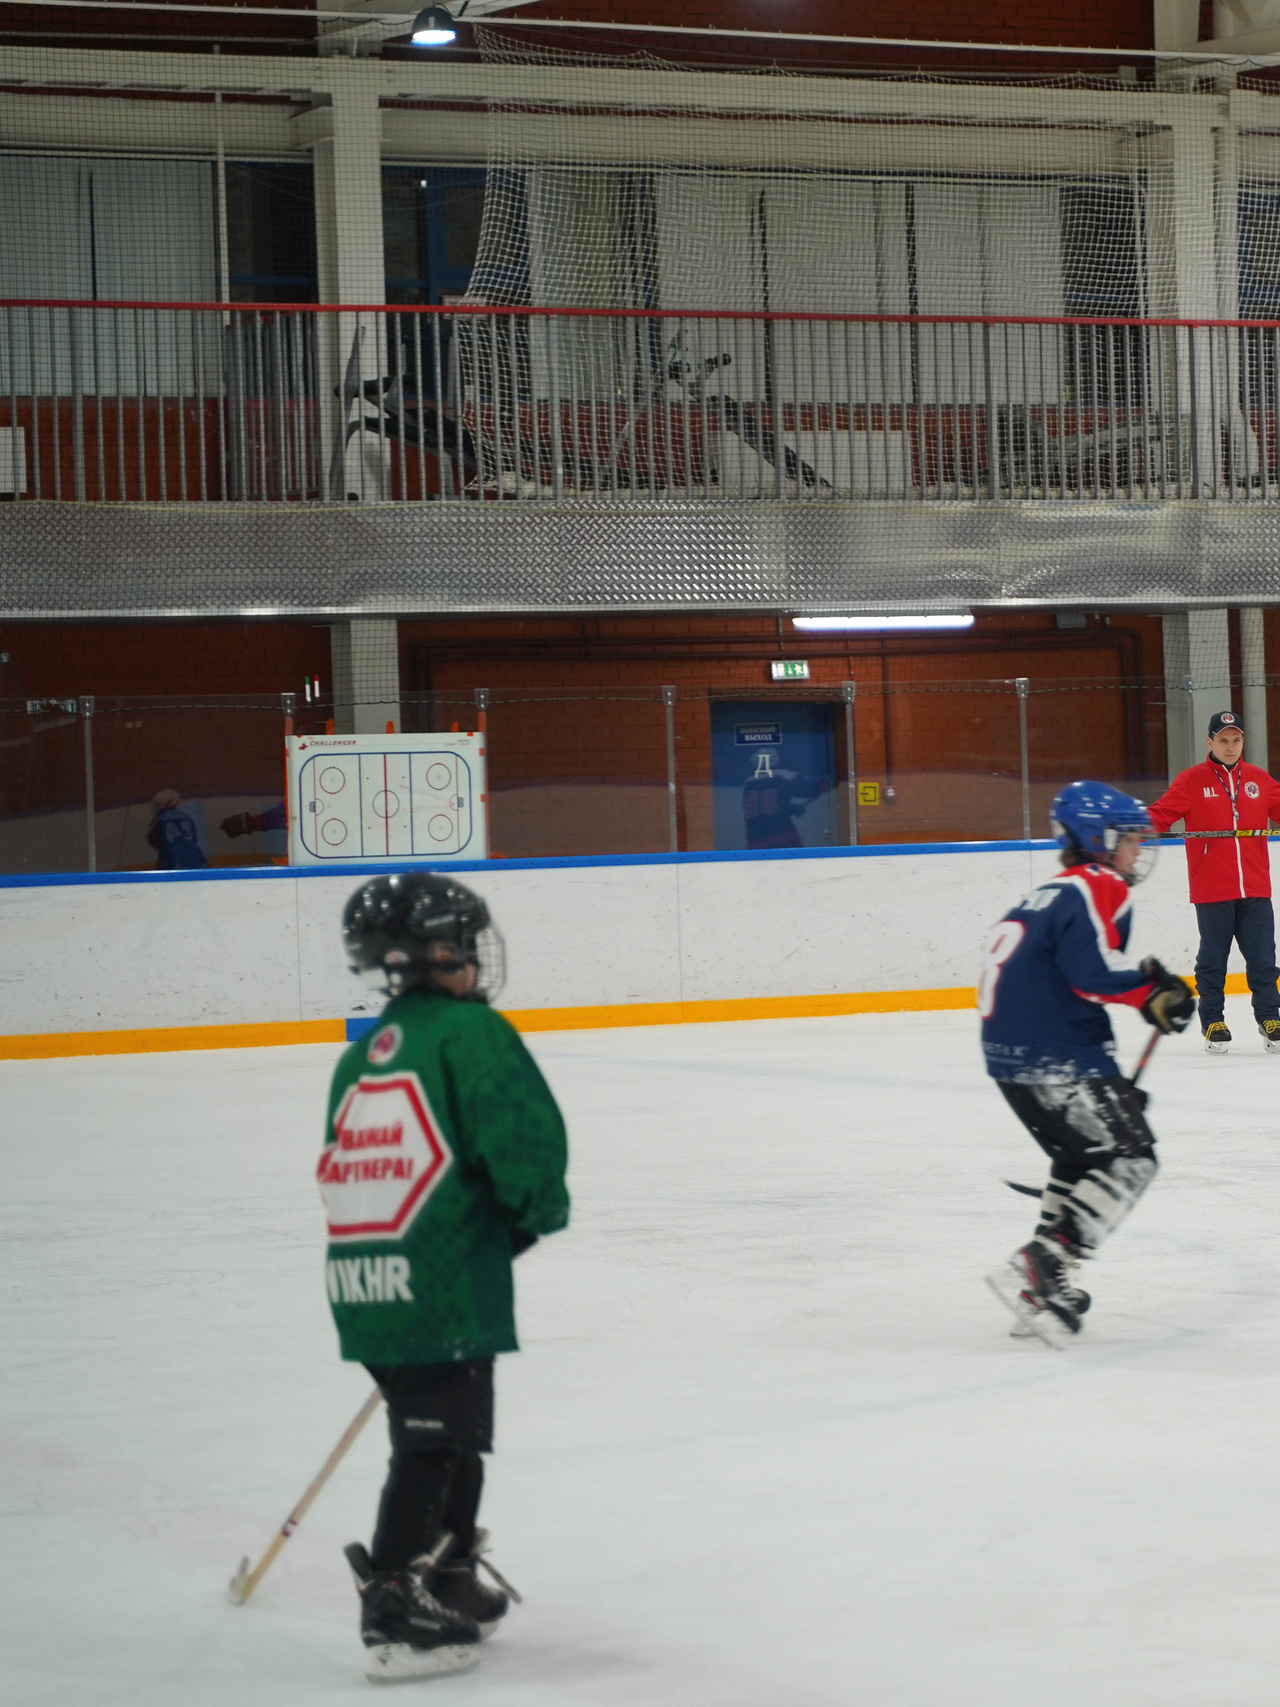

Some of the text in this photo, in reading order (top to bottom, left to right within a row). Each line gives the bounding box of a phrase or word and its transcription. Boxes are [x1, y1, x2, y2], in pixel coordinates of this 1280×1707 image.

[754, 754, 773, 779] Д
[1203, 786, 1220, 798] M.L.
[341, 1122, 403, 1150] ВАЖАЙ
